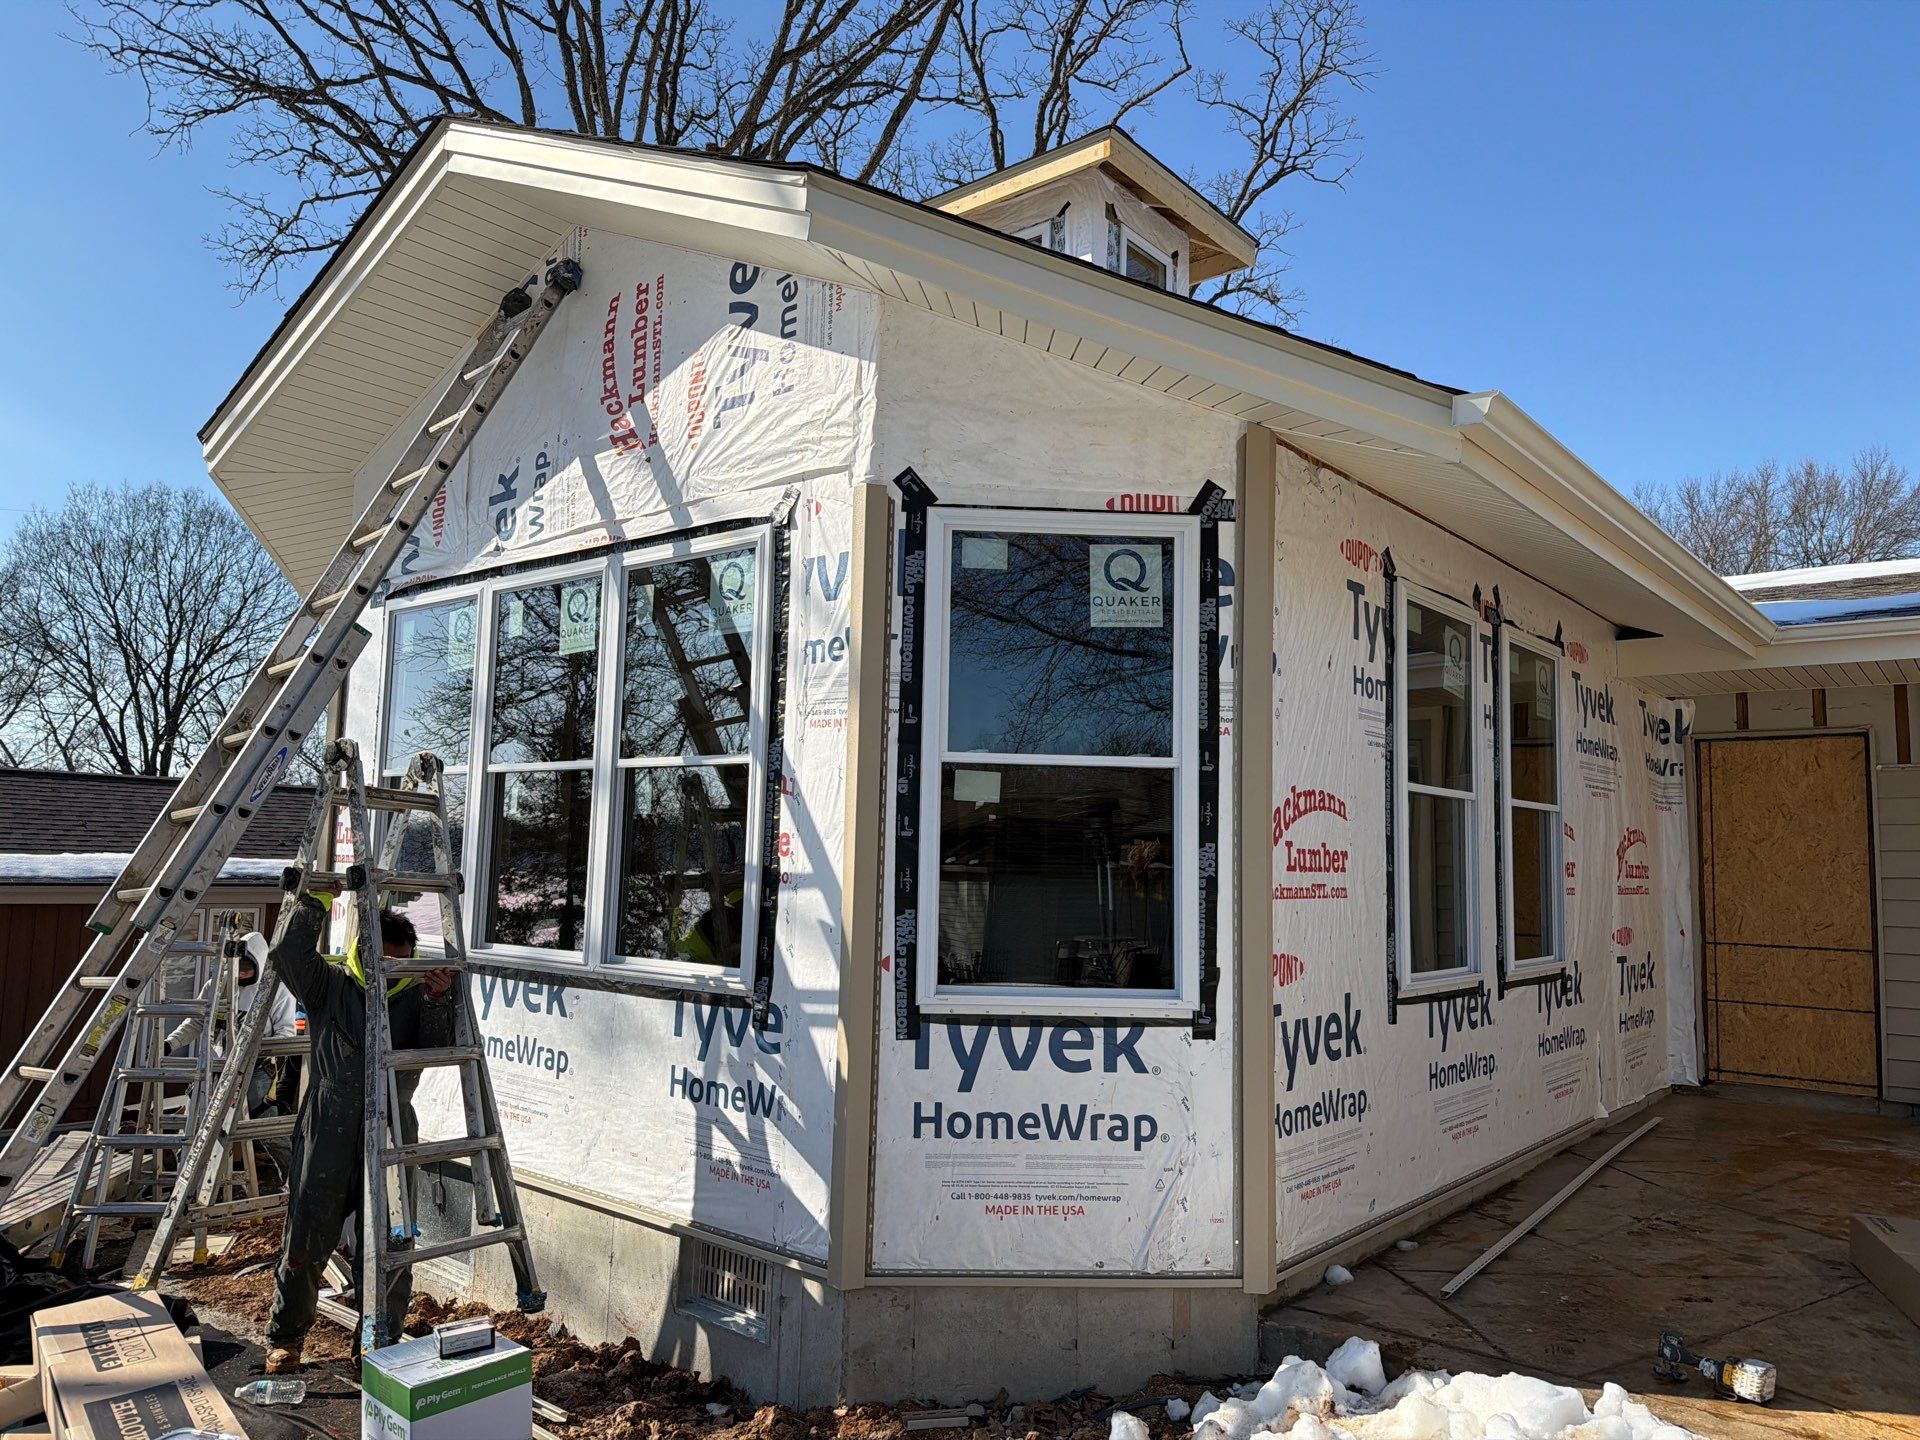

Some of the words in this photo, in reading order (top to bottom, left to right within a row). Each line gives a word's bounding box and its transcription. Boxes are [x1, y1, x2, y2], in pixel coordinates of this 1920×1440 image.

[628, 283, 649, 408] Lumber
[648, 274, 664, 447] HackmannSTL.com
[600, 292, 646, 456] Hackmann
[904, 553, 915, 594] WRAP
[914, 550, 925, 584] DECK
[711, 603, 753, 618] QUAKER
[1092, 596, 1161, 607] QUAKER
[1206, 598, 1216, 631] DECK
[560, 623, 594, 638] QUAKER
[902, 597, 914, 682] POWERBOND
[1199, 644, 1209, 730] POWERBOND
[1571, 670, 1615, 728] Tyvek
[809, 717, 832, 728] MADE
[767, 742, 777, 781] WRAP
[764, 782, 774, 866] POWERBOND
[1206, 842, 1216, 877] DECK
[1285, 840, 1348, 873] Lumber
[1273, 883, 1348, 900] ckmannSTL.com
[895, 914, 908, 955] WRAP
[905, 909, 916, 944] DECK
[1617, 951, 1655, 1006] Tyvek
[470, 973, 568, 1021] yvek
[1538, 1025, 1585, 1058] HomeWrap
[1429, 1051, 1495, 1091] HomeWrap
[914, 1101, 1158, 1151] HomeWrap
[709, 1165, 729, 1180] MADE
[731, 1171, 739, 1181] IN
[740, 1173, 754, 1186] THE
[756, 1178, 771, 1190] USA
[1301, 1188, 1315, 1201] MADE
[1322, 1182, 1331, 1192] THE
[1332, 1178, 1342, 1189] USA
[950, 1192, 966, 1200] Call
[968, 1192, 1031, 1201] 1-800-448-9835
[1035, 1192, 1122, 1203] tyvek.com/homewrap
[985, 1205, 1019, 1216] MADE
[1022, 1205, 1034, 1216] IN
[1037, 1205, 1059, 1216] THE
[1062, 1205, 1085, 1216] USA
[426, 1391, 440, 1404] Ply
[441, 1387, 461, 1398] Gem
[471, 1375, 506, 1390] PERFORMANCE
[506, 1368, 527, 1380] METALS
[373, 1402, 387, 1430] Ply
[387, 1415, 406, 1439] Gem
